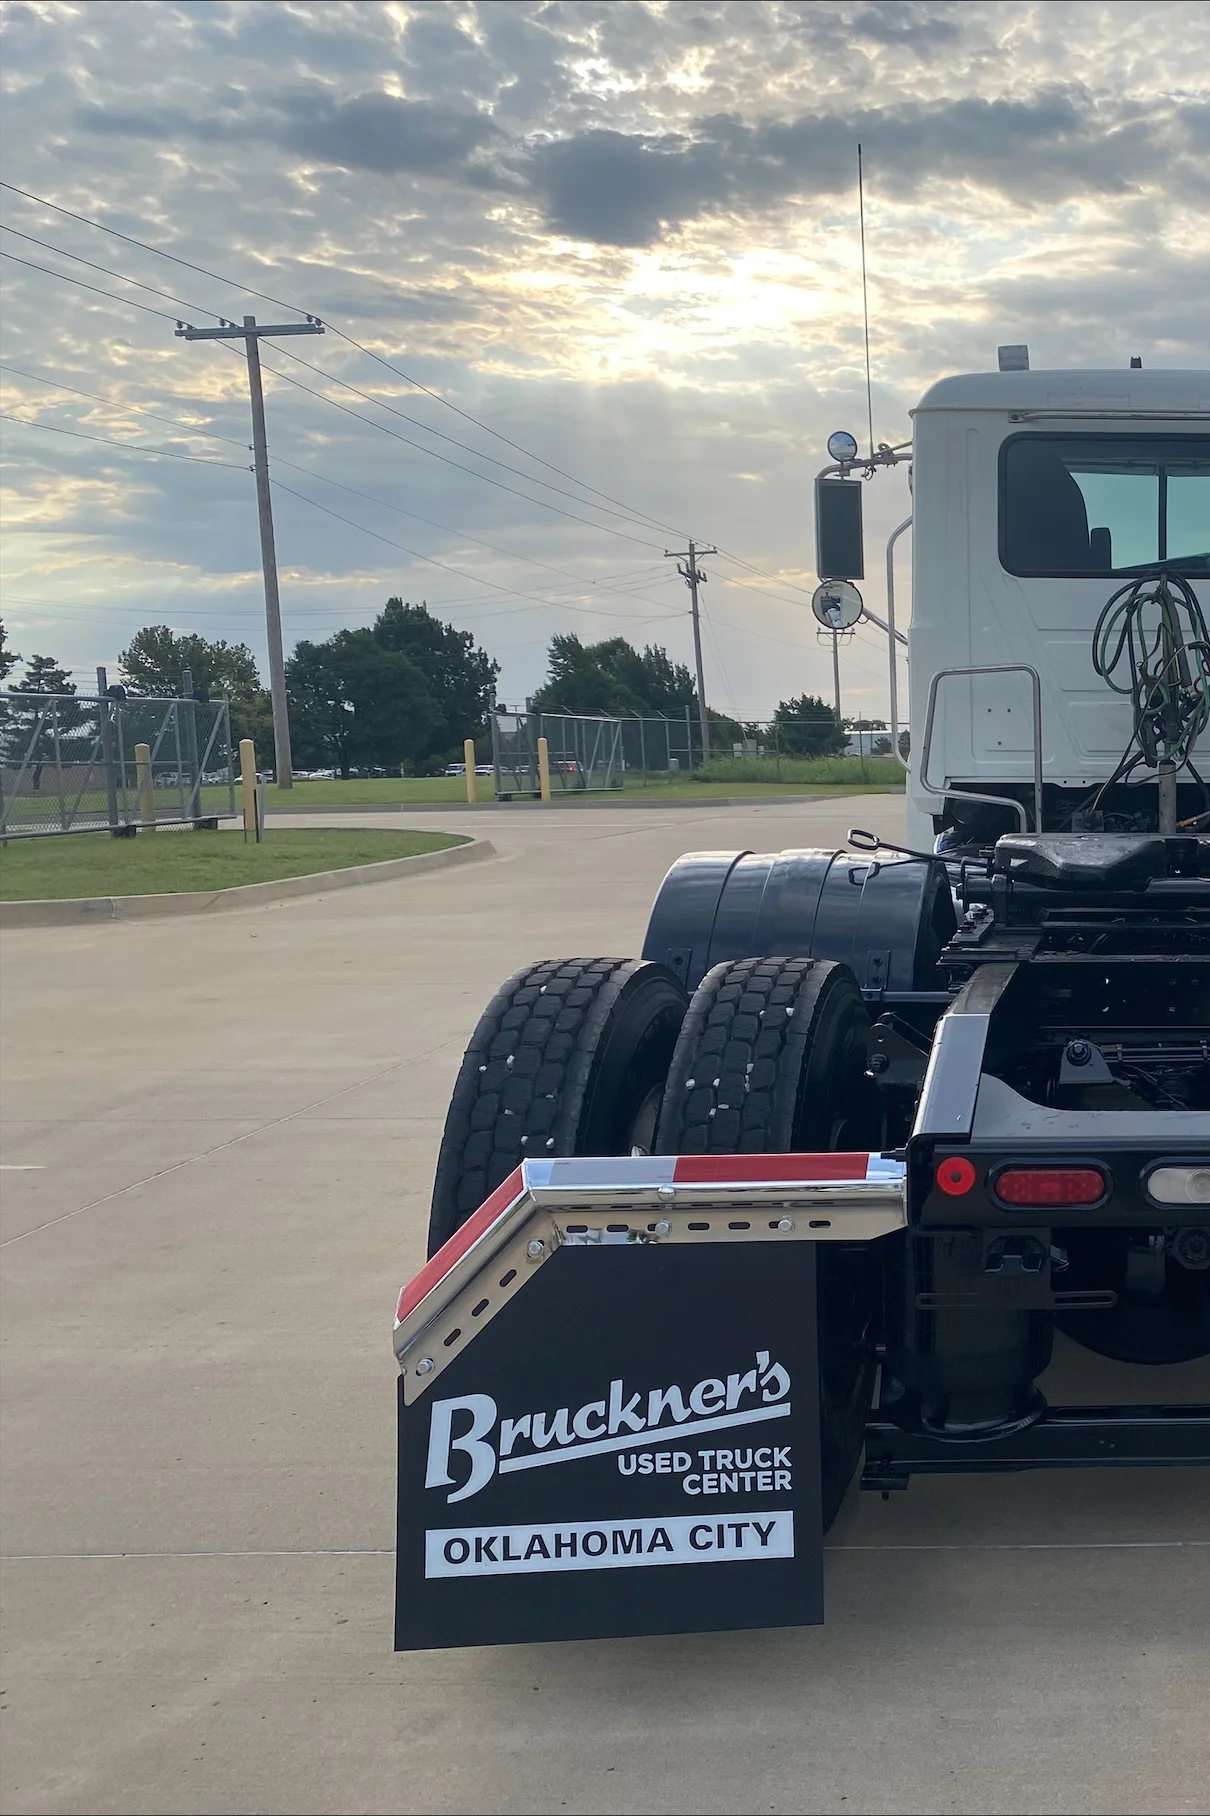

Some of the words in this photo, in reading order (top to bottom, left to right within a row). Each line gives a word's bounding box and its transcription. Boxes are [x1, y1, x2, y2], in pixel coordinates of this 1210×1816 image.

[424, 1350, 792, 1504] Bruckner's
[617, 1451, 692, 1475] USED
[698, 1446, 792, 1470] TRUCK
[682, 1471, 792, 1496] CENTER
[443, 1526, 674, 1564] OKLAHOMA
[689, 1521, 777, 1550] CITY
